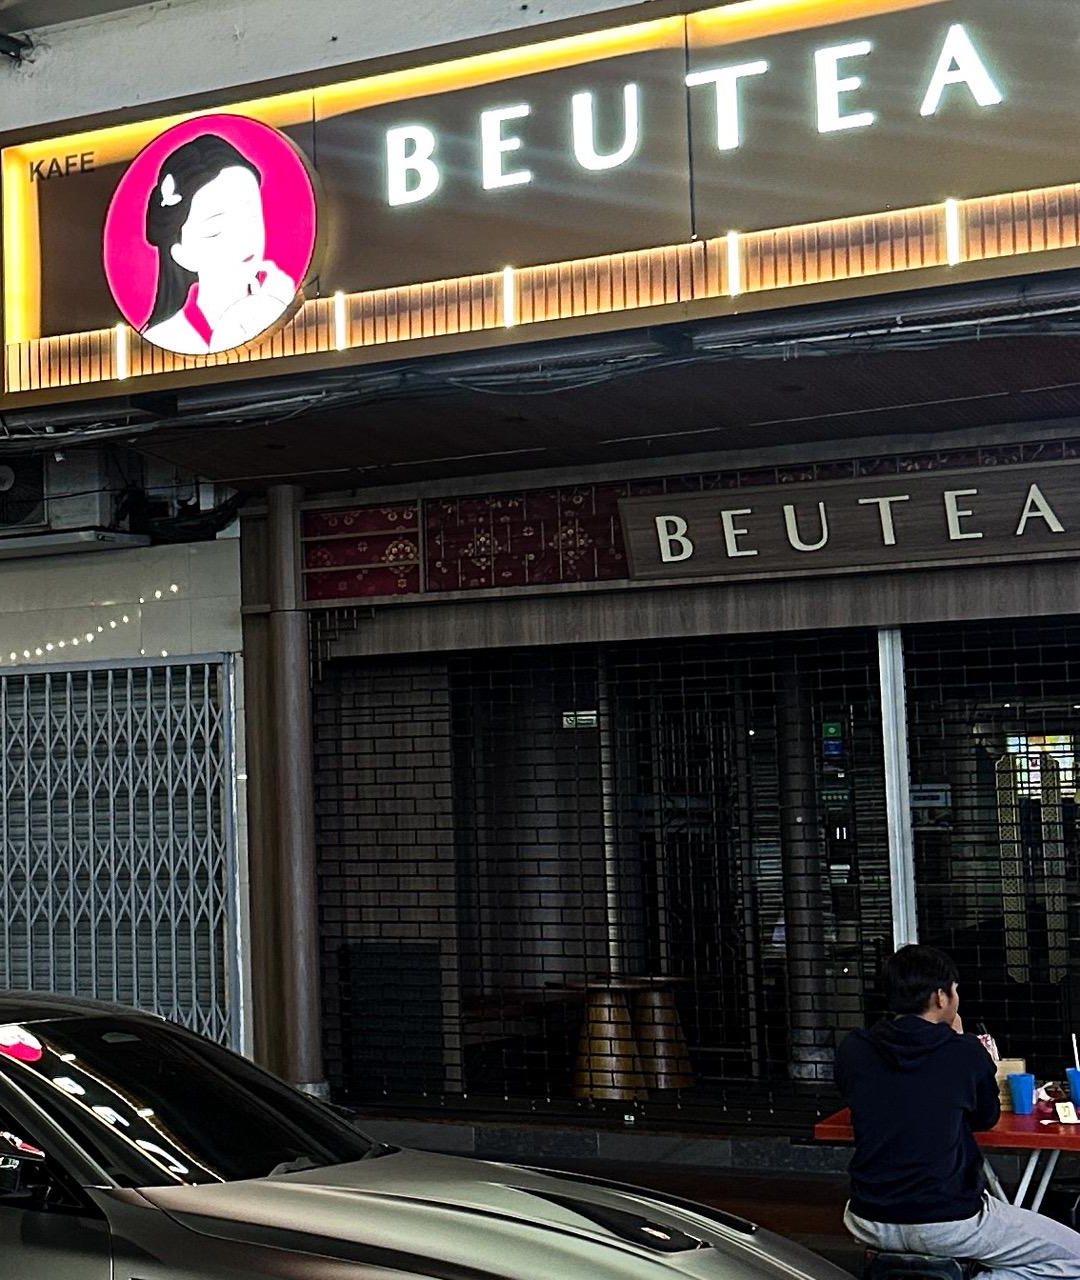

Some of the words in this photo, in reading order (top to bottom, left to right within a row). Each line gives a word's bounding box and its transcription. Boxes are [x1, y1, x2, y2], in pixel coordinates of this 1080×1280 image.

[385, 23, 1004, 207] BEUTEA
[29, 151, 95, 183] KAFE
[654, 483, 1066, 564] BEUTEA
